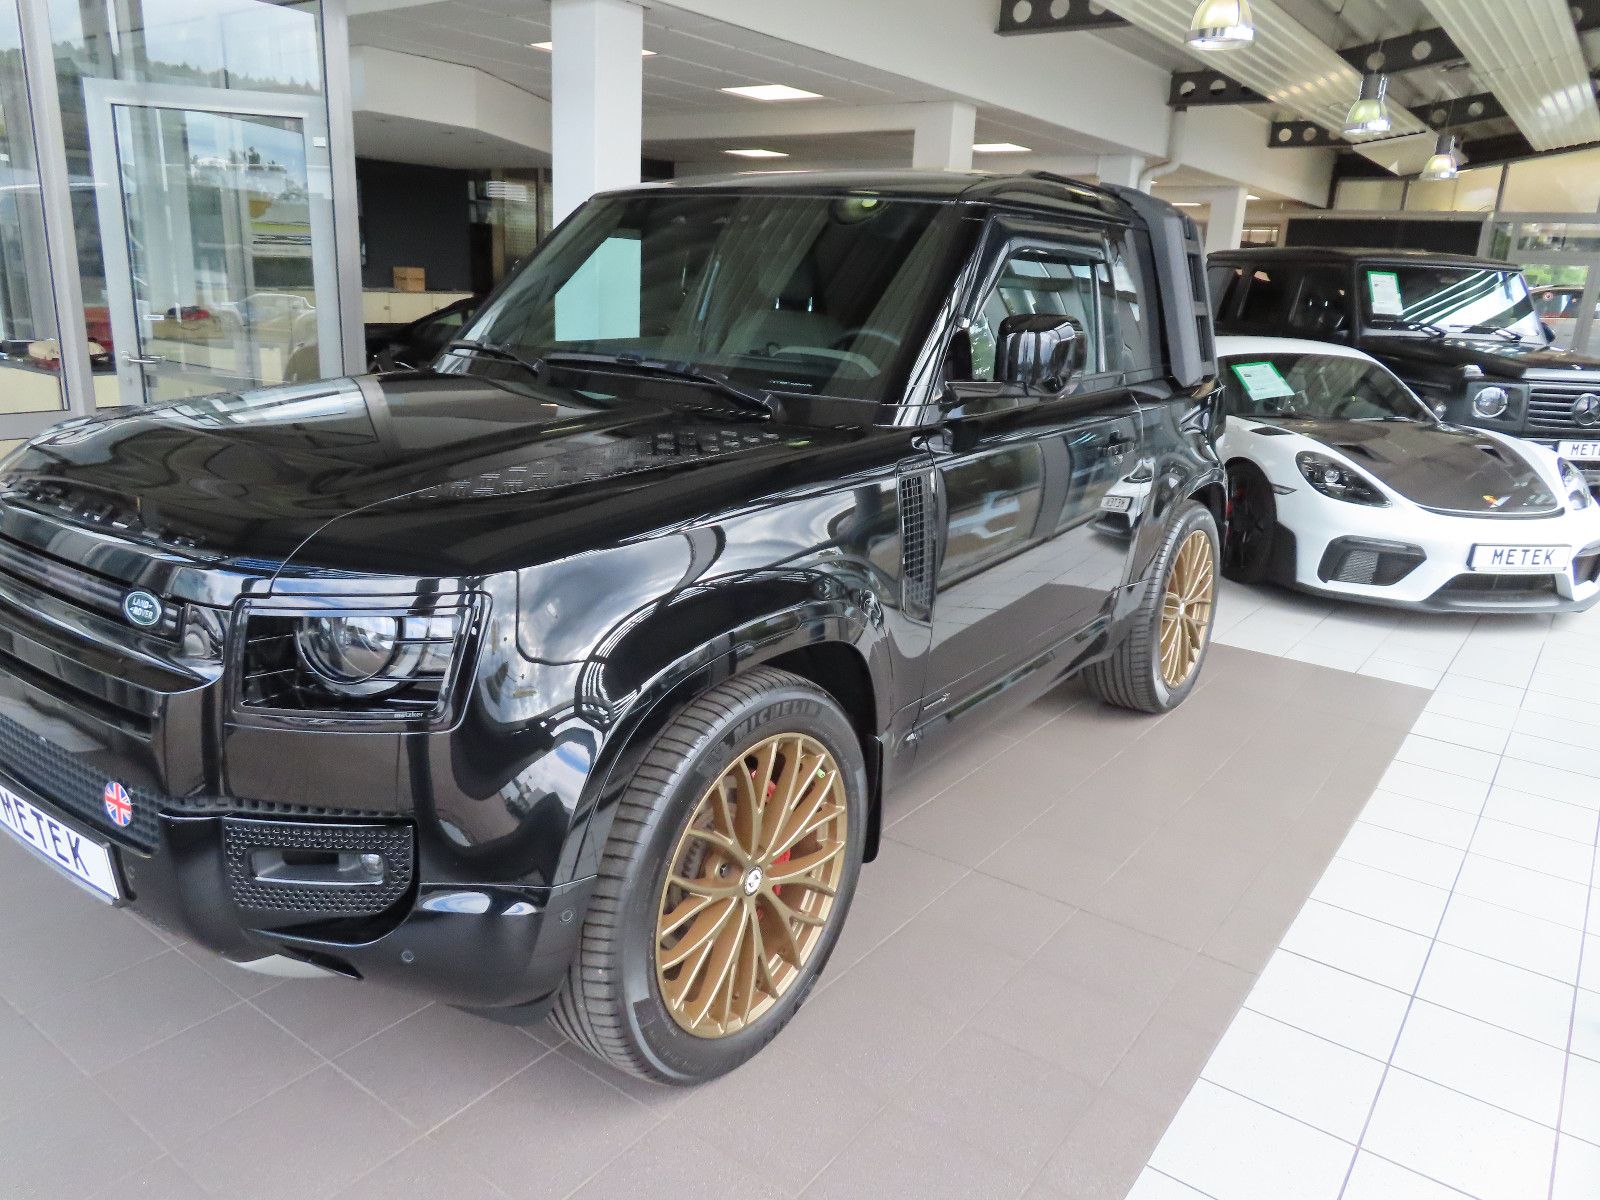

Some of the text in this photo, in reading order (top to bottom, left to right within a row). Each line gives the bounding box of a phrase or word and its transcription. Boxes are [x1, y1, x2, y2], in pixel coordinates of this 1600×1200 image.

[1571, 443, 1600, 456] MET
[1491, 549, 1555, 565] METEK
[132, 597, 150, 608] LAND
[131, 607, 153, 620] ROVER
[734, 700, 821, 744] MICHELIN
[0, 791, 90, 877] METEK
